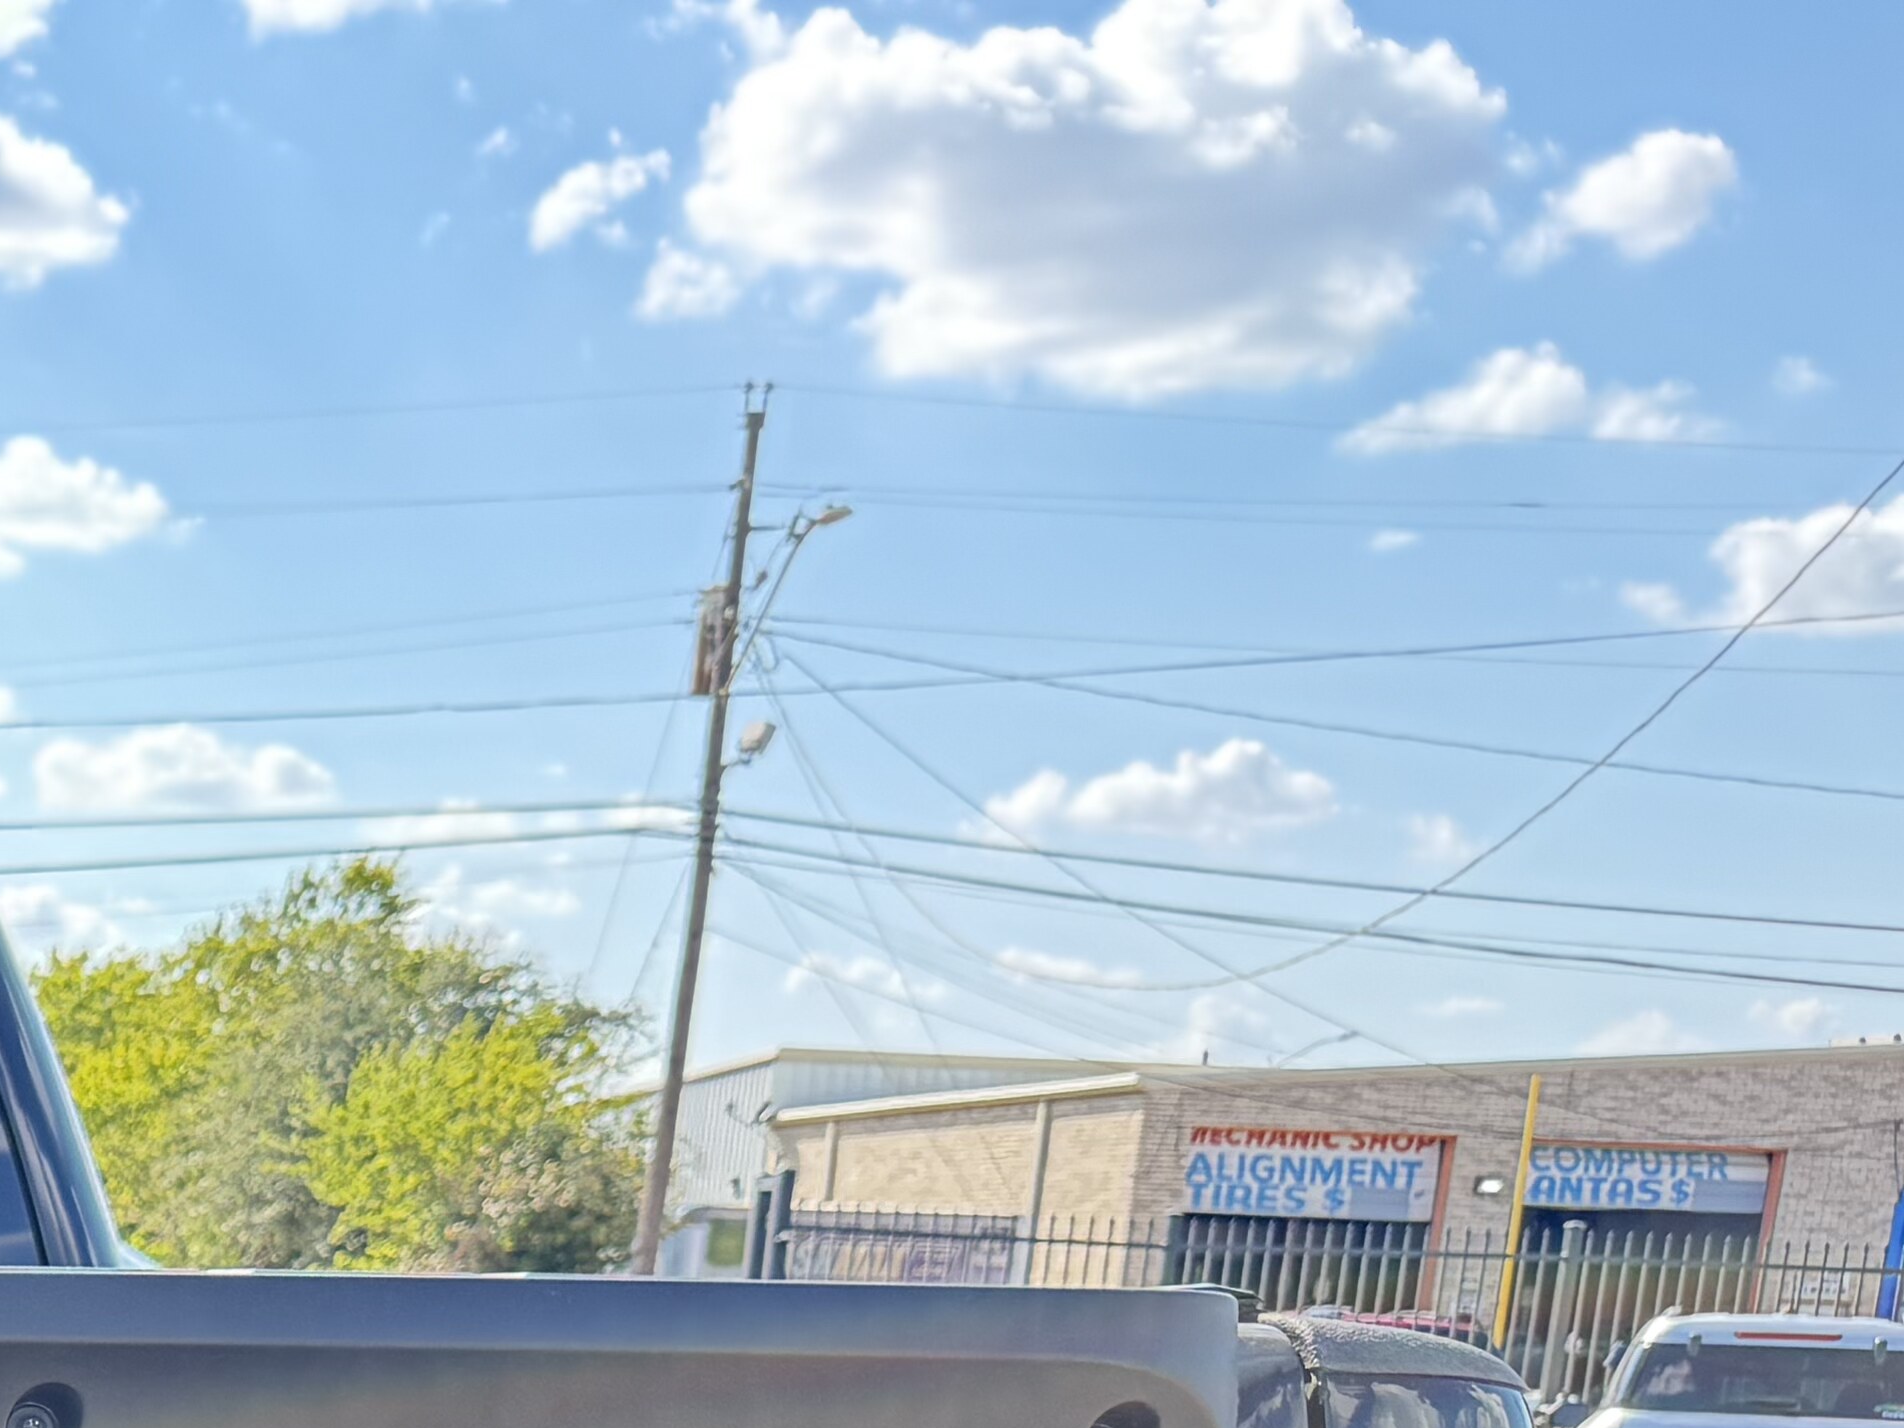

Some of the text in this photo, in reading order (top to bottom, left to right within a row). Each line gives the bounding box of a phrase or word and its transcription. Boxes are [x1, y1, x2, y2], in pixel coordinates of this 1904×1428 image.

[1185, 1151, 1423, 1189] ALIGNMENT
[1529, 1146, 1729, 1181] COMPUTER
[1187, 1182, 1307, 1214] TIRES
